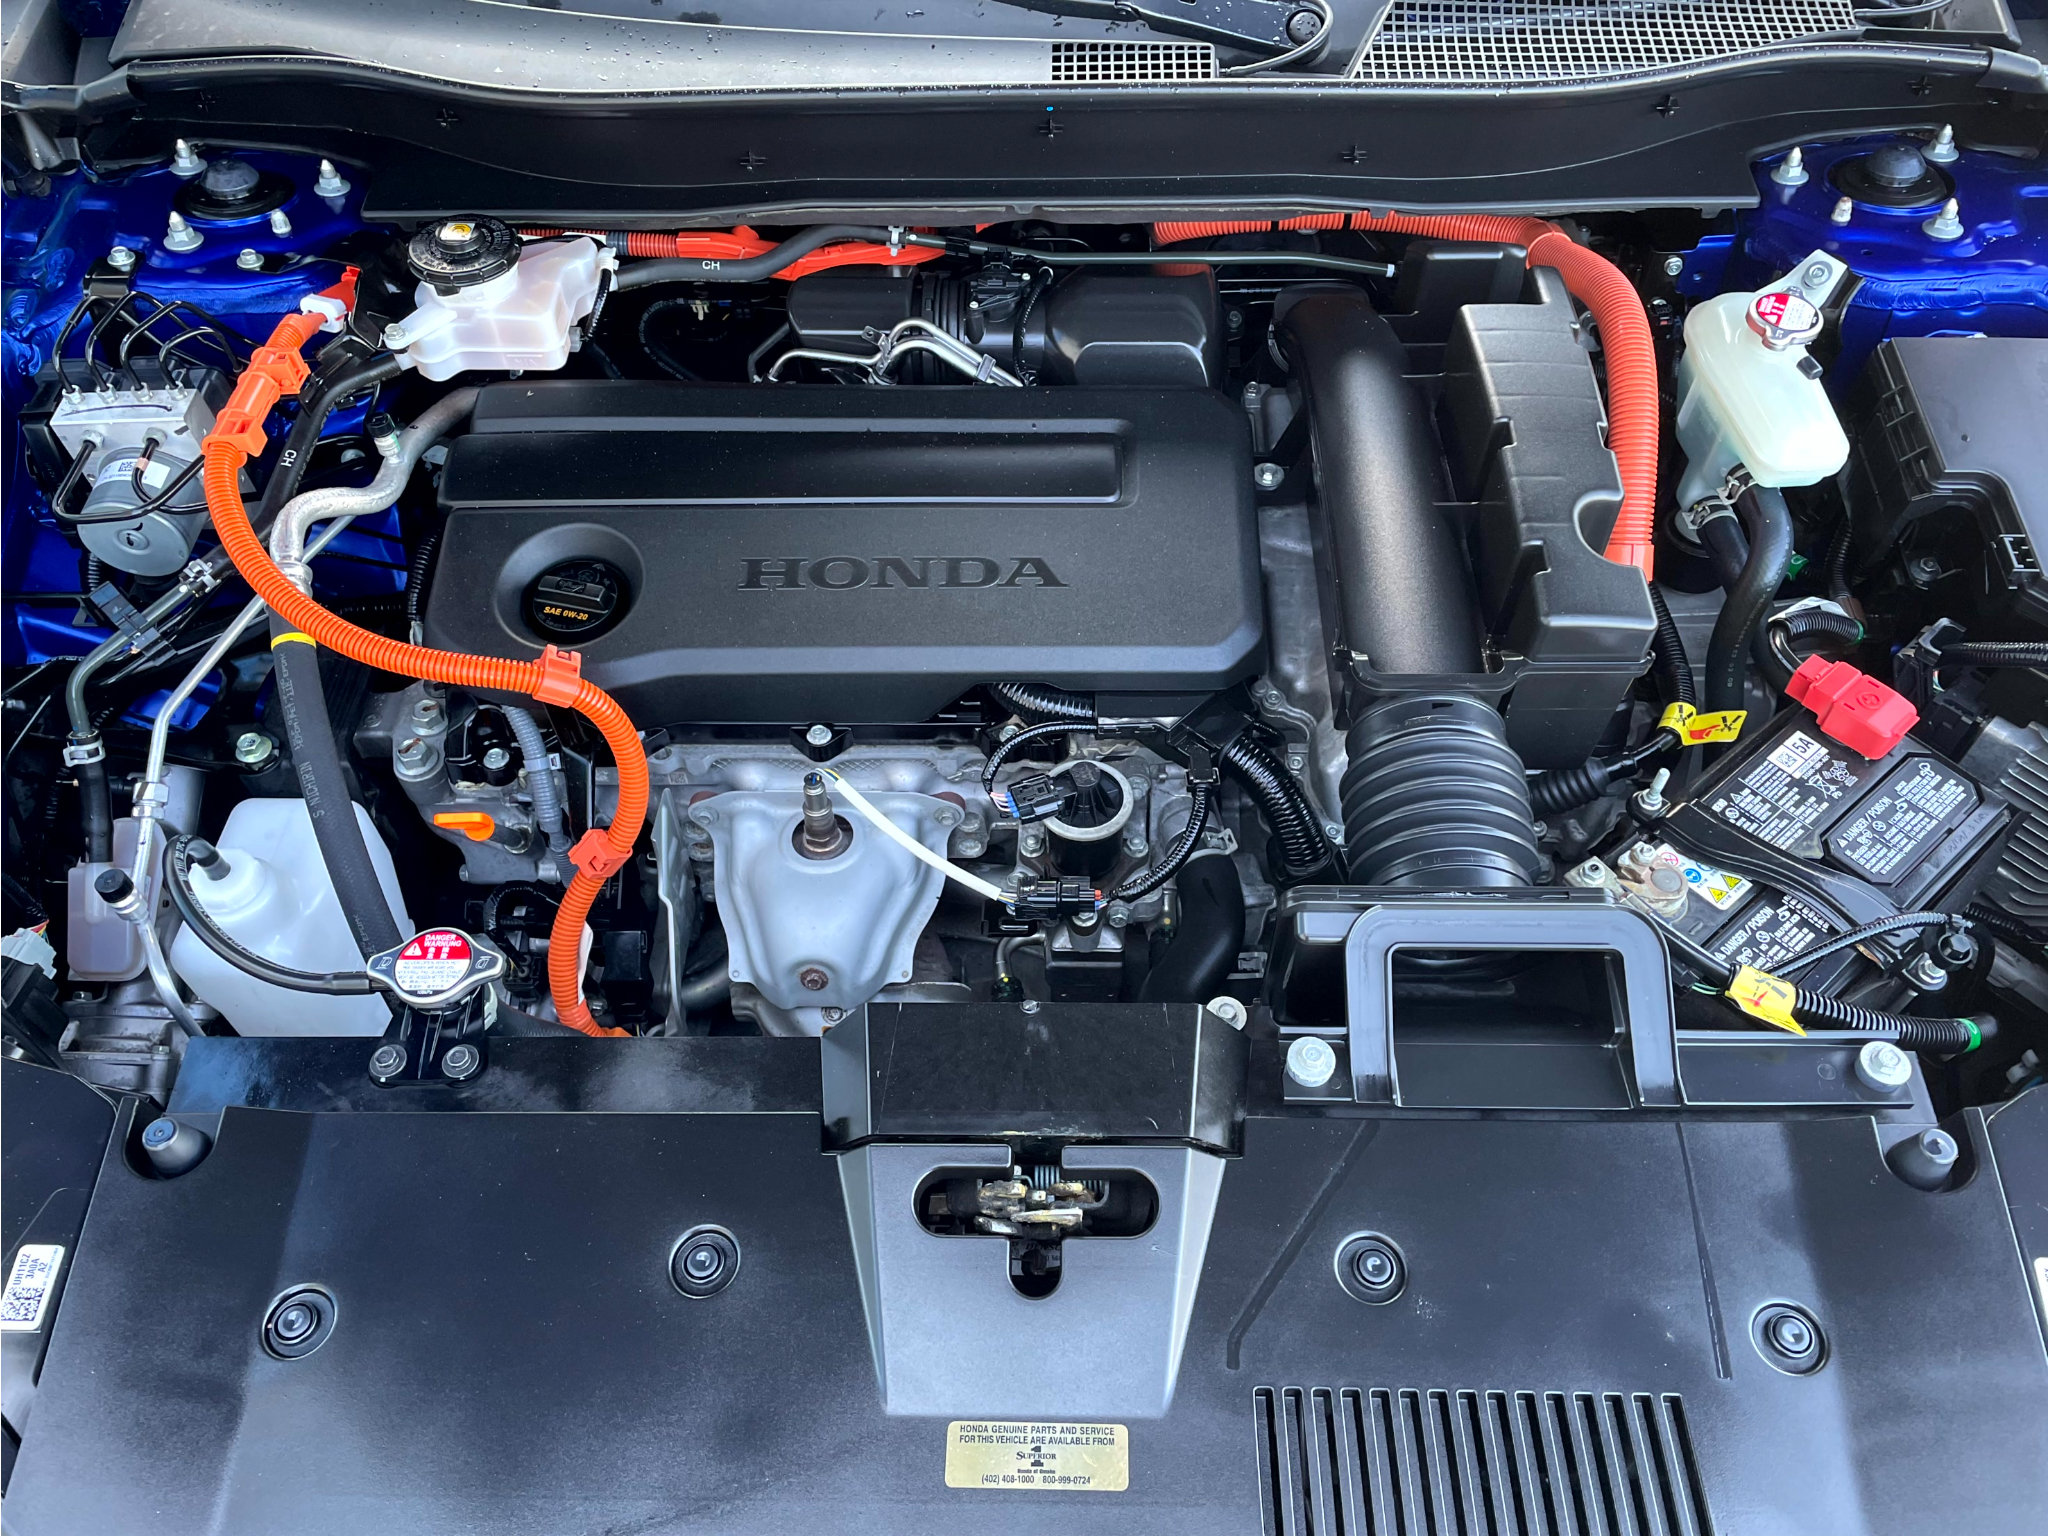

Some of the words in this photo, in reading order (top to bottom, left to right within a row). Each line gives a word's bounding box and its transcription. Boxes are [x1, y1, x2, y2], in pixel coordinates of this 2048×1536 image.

[702, 260, 720, 271] CH
[280, 450, 297, 467] CH
[737, 556, 1071, 591] HONDA
[543, 606, 562, 616] SAE
[562, 610, 589, 621] 0W-20
[1792, 737, 1815, 754] 5A
[1842, 813, 1869, 842] DANGER
[1867, 795, 1893, 822] POISON
[424, 934, 457, 942] DANGER
[1720, 930, 1749, 959] DANGER
[1749, 905, 1775, 931] POISON
[423, 940, 462, 948] WARNUNG
[13, 1253, 31, 1286] UH11CZ
[38, 1262, 48, 1273] A2
[960, 1424, 989, 1434] HONDA
[991, 1425, 1028, 1434] GENUINE
[1030, 1426, 1057, 1435] PARTS
[1059, 1426, 1077, 1435] AND
[1079, 1427, 1115, 1436] SERVICE
[959, 1435, 975, 1444] FOR
[977, 1435, 994, 1444] THIS
[996, 1435, 1028, 1445] VEHICLE
[1030, 1436, 1046, 1445] ARE
[1048, 1437, 1091, 1446] AVAILABLE
[1092, 1437, 1115, 1446] FROM
[981, 1474, 1000, 1485] (402)
[1001, 1475, 1035, 1485] 408-1000
[1042, 1475, 1091, 1485] 800-999-0724
